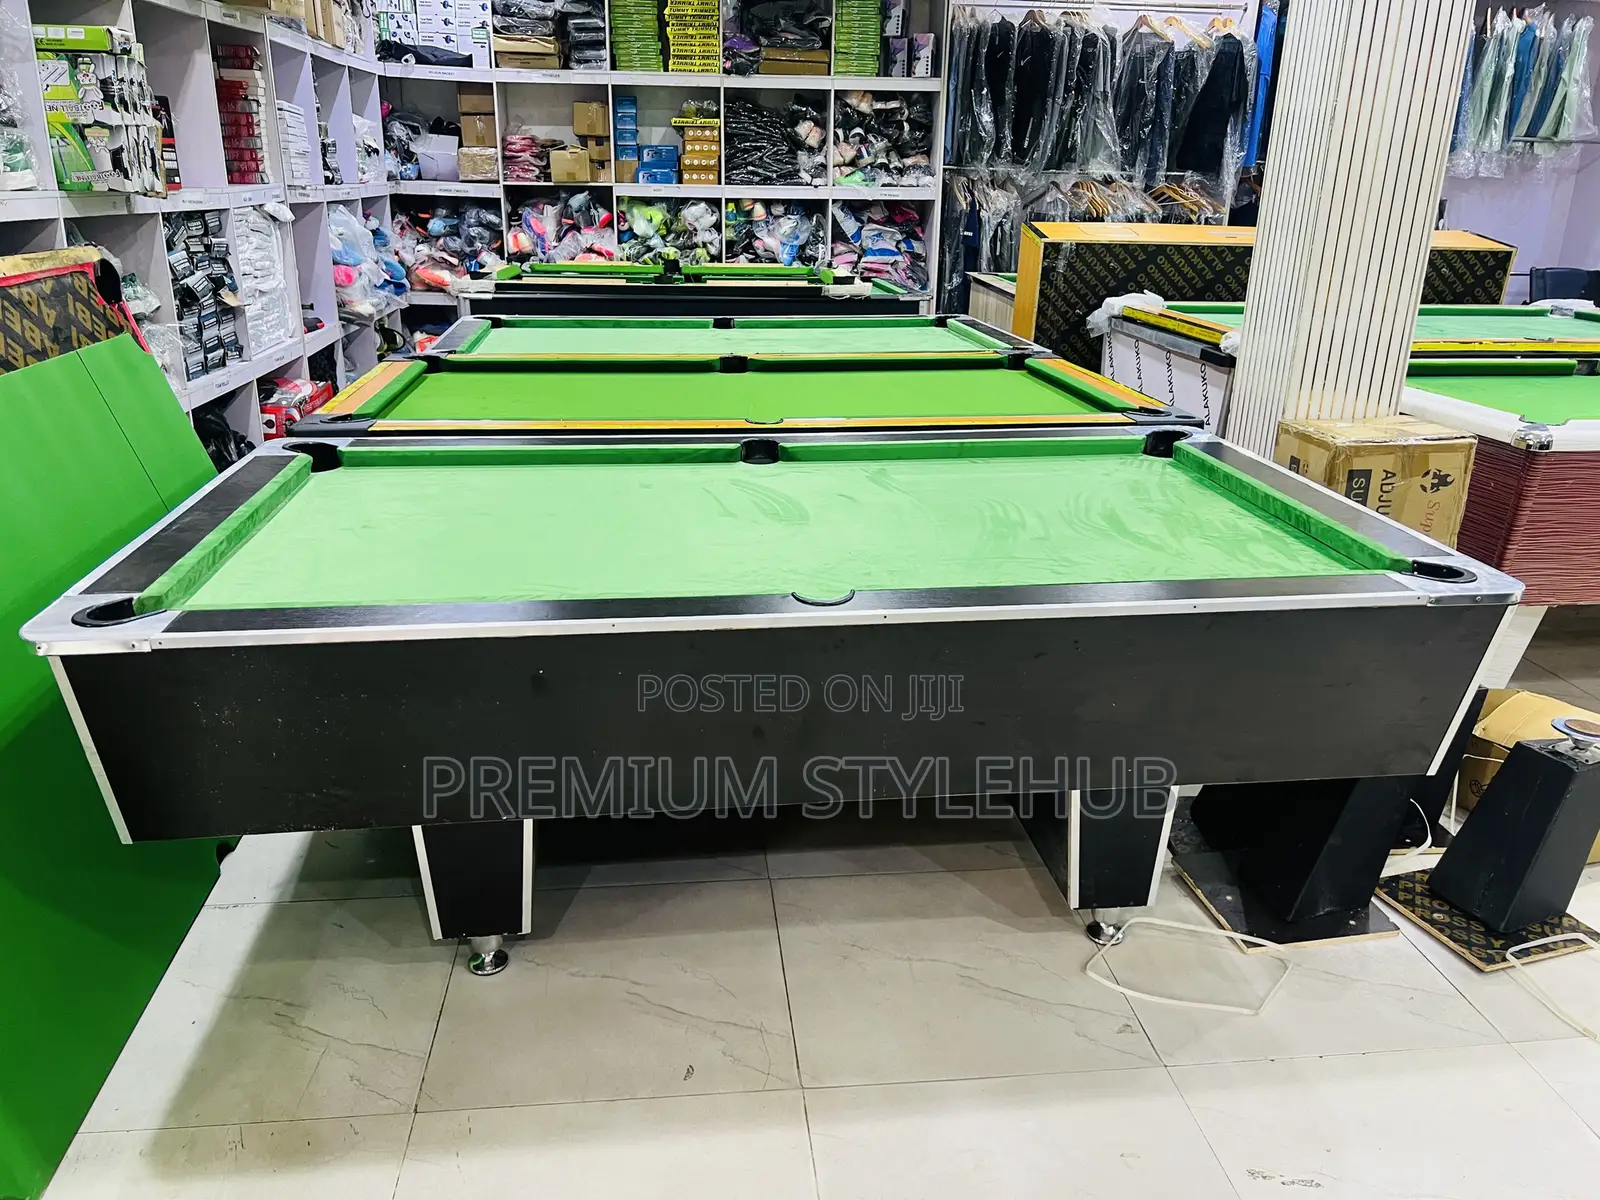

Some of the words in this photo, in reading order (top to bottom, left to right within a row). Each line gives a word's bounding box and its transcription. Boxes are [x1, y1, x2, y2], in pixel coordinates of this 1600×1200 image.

[1068, 254, 1107, 296] ALAKUKO
[1078, 245, 1116, 287] ALAKUKO
[1157, 256, 1195, 298] ALAKUKO
[1167, 246, 1204, 288] ALAKUKO
[1200, 363, 1211, 426] ALAKUKO
